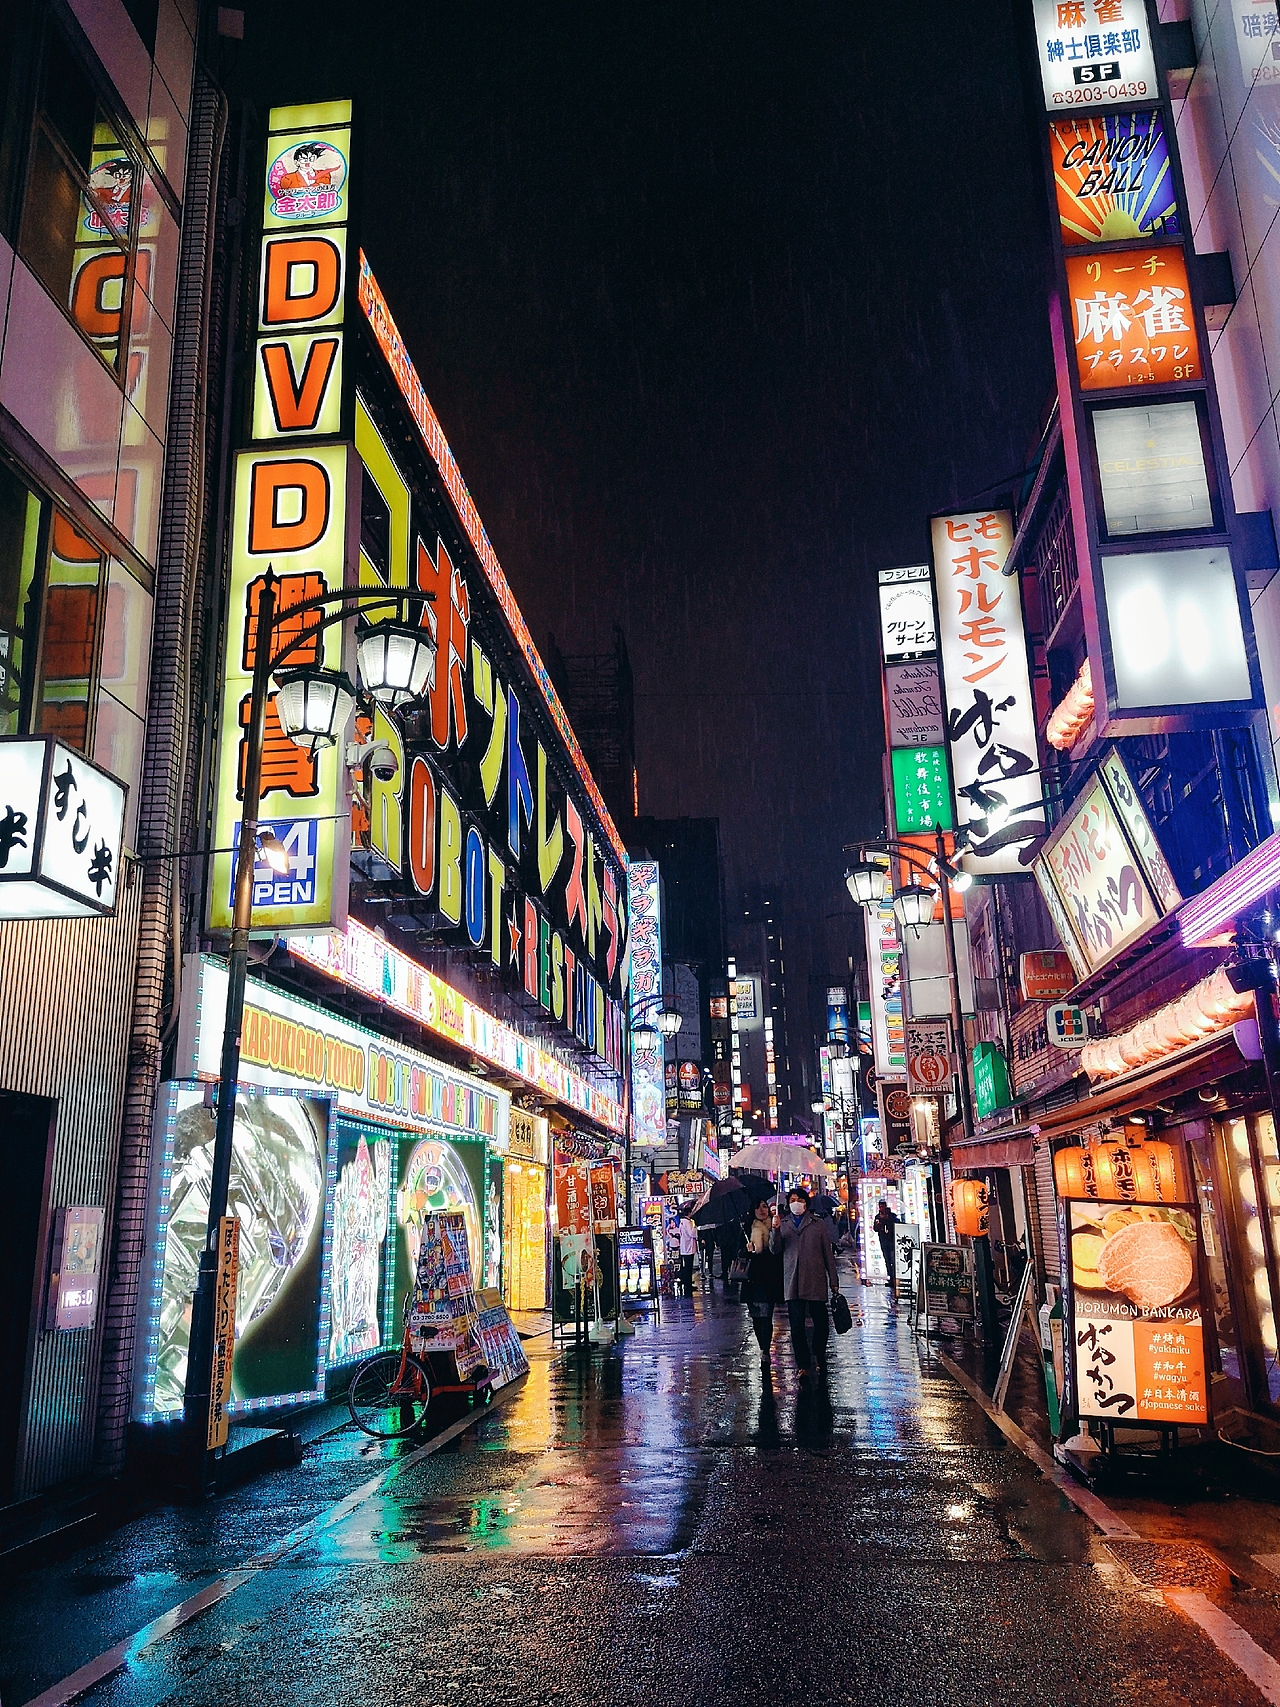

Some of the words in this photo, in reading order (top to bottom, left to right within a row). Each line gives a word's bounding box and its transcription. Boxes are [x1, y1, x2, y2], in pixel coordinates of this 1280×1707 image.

[1057, 0, 1125, 29] 麻雀
[1047, 29, 1141, 62] 紳士倶楽部
[1065, 81, 1147, 104] 3203-0439
[1062, 131, 1163, 170] CANON
[1076, 165, 1146, 198] BALL
[277, 193, 336, 213] 金太郎
[1142, 216, 1177, 236] 4F
[1086, 256, 1166, 281] リーチ
[1075, 285, 1190, 344] 麻雀
[1084, 344, 1190, 369] プラスワン
[1127, 372, 1155, 383] 1-2-5
[1173, 364, 1194, 379] 3F
[1102, 455, 1200, 473] CELESTIAL
[945, 513, 1002, 543] ヒモ
[884, 568, 929, 581] フジビル
[952, 546, 1009, 684] ホルモン
[887, 620, 926, 634] グリーン
[896, 631, 936, 646] サービス
[902, 651, 923, 660] 4F
[914, 751, 933, 828] 歌舞伎市場
[1110, 765, 1177, 900] もつ鍋
[1058, 803, 1112, 889] ホルモン
[234, 881, 311, 905] PEN
[371, 701, 505, 967] ROBOT
[524, 895, 626, 1079] RESTAURANT
[630, 866, 658, 1069] ギラギラガース
[1056, 1018, 1082, 1027] JCB
[240, 1005, 324, 1079] KABUKICHO
[326, 1037, 364, 1091] TOKYO
[908, 1030, 946, 1045] 駄菓子
[910, 1044, 947, 1057] 居酒屋
[370, 1049, 410, 1107] ROBOT
[411, 1067, 442, 1120] SHOW
[449, 1083, 499, 1141] RESTAURANT
[685, 1182, 702, 1193] 受付
[1076, 1302, 1138, 1316] HORUMON
[1141, 1306, 1201, 1319] BANKARA
[1149, 1344, 1191, 1354] #yakiniku
[1153, 1361, 1187, 1374] #和牛
[1153, 1372, 1187, 1383] #wagyu
[1143, 1388, 1200, 1401] #日本清酒
[1140, 1399, 1183, 1410] #japanese
[1185, 1403, 1206, 1412] sake
